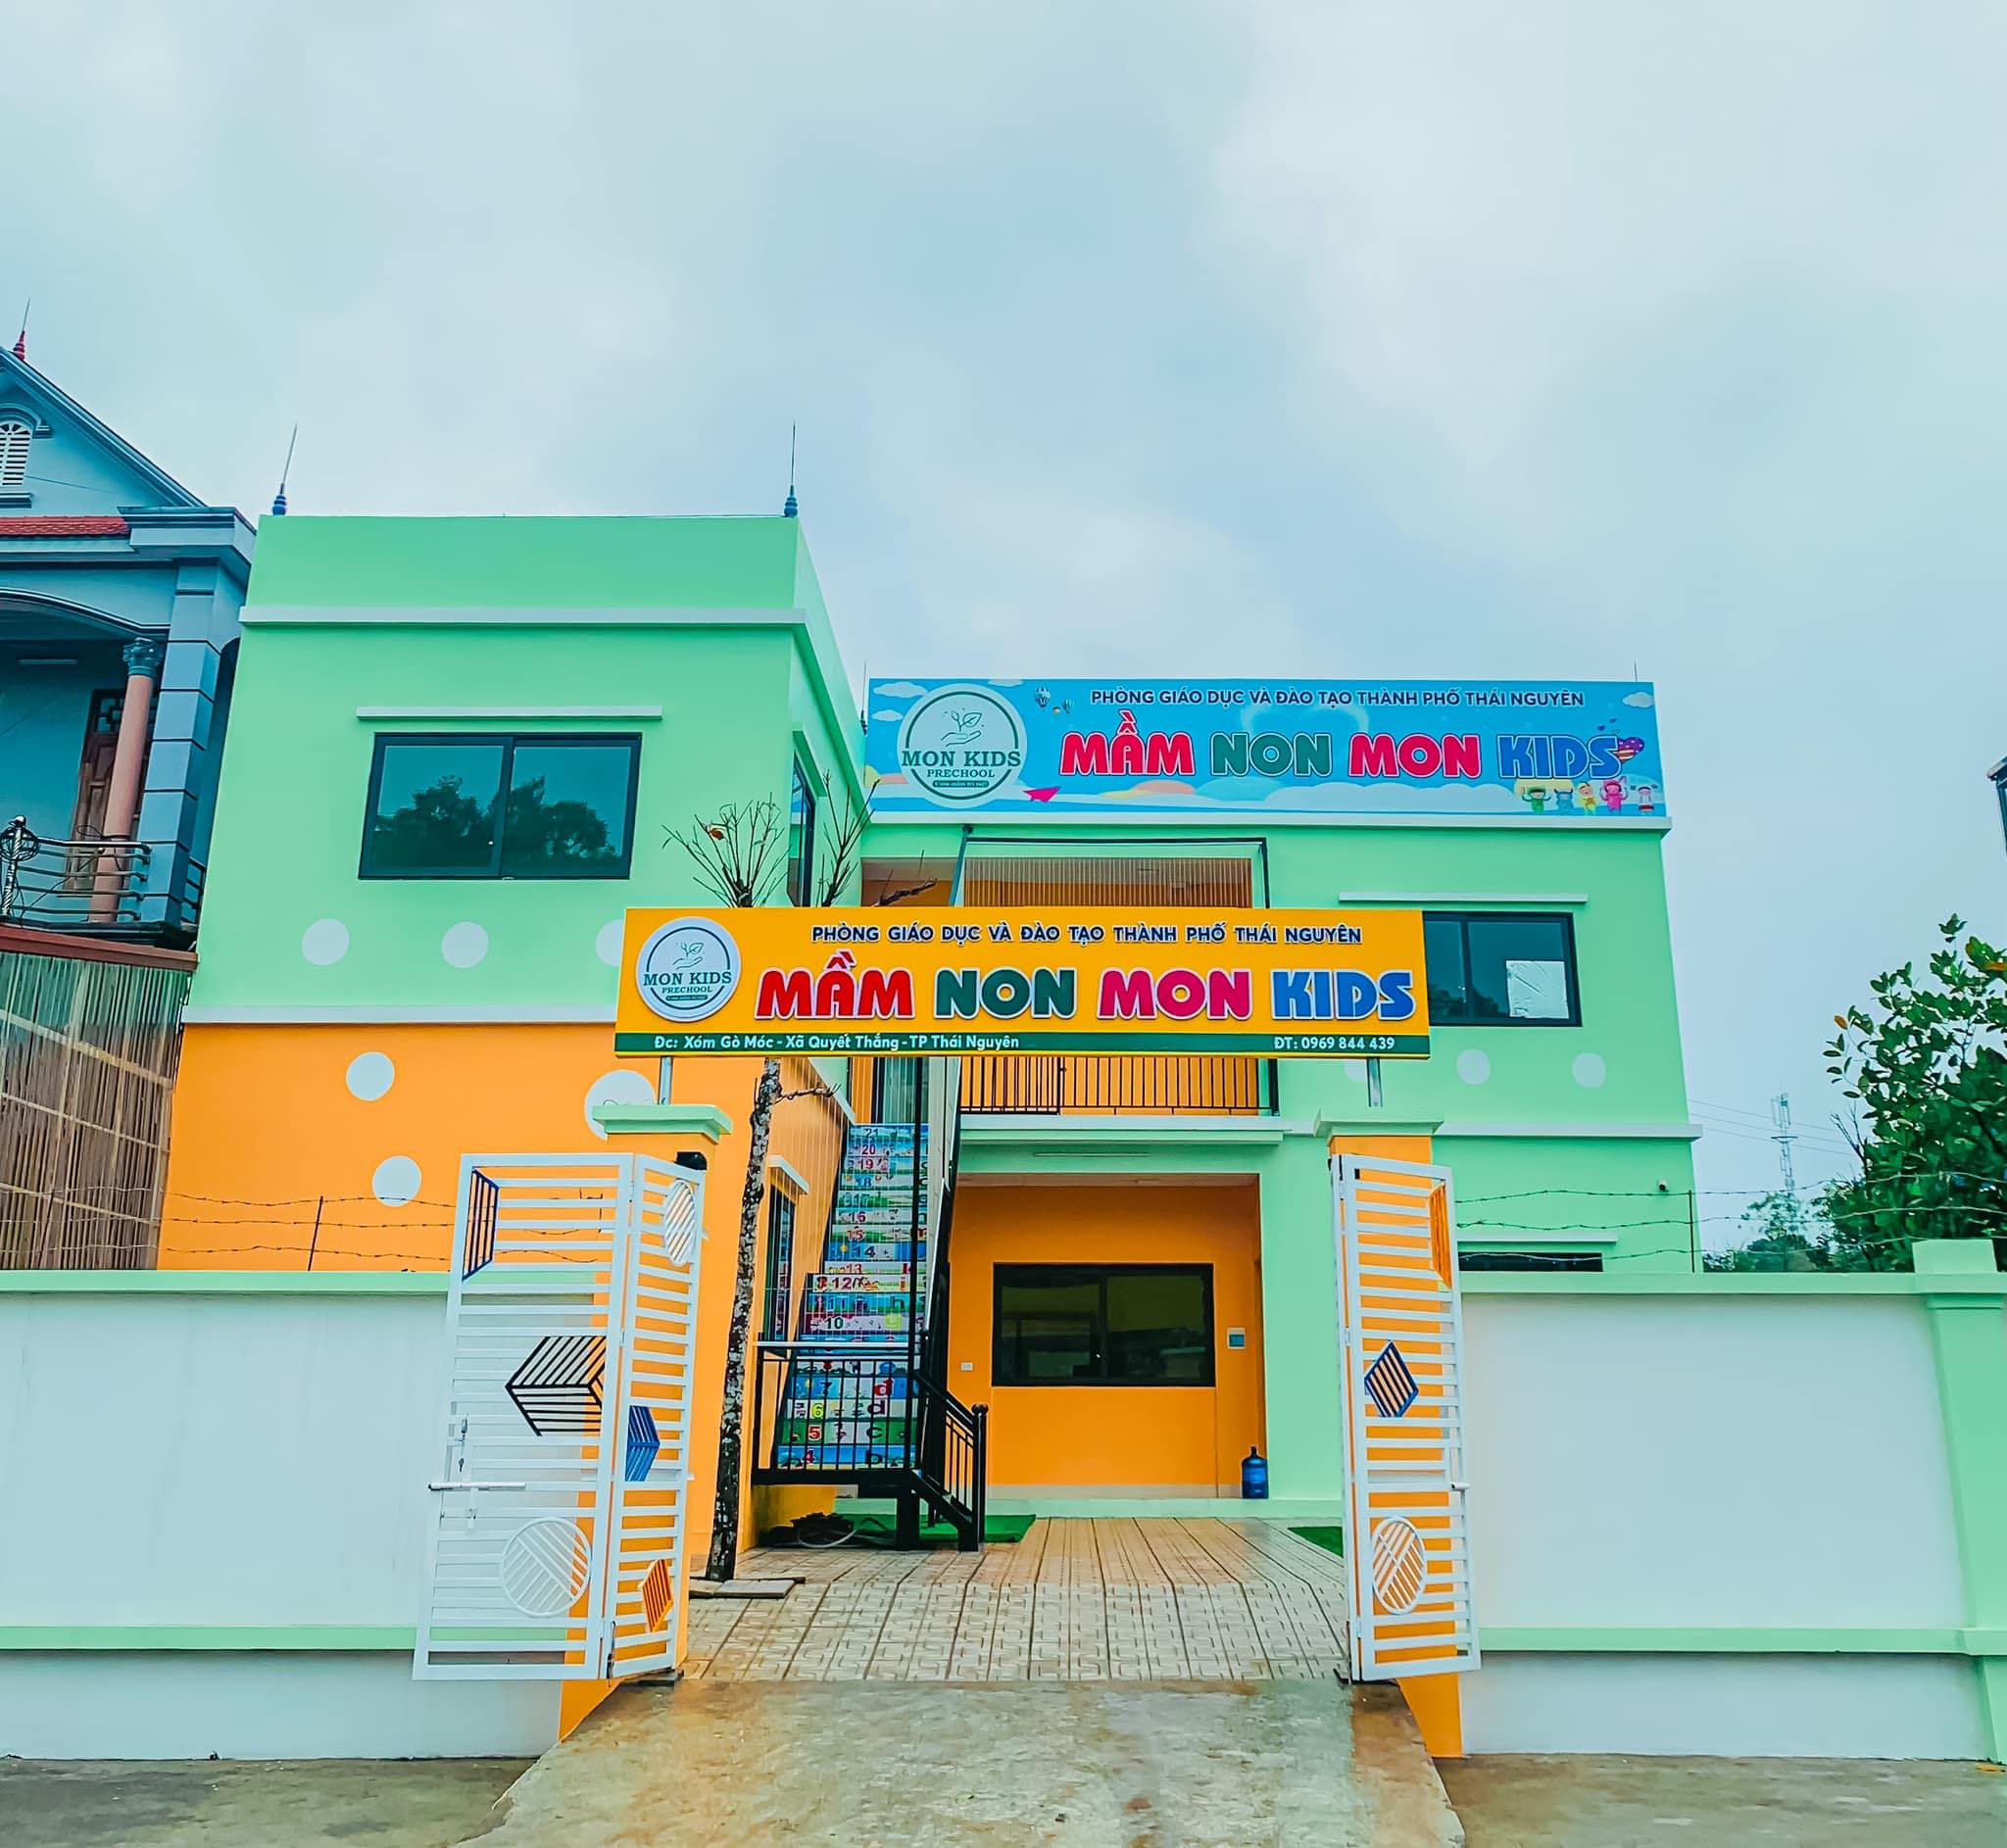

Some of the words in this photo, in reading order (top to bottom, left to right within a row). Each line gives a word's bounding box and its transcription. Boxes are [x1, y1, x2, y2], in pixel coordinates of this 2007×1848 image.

[1091, 687, 1153, 704] PHÒNG
[1159, 687, 1202, 704] GIÁO
[1207, 690, 1244, 707] DỤC
[1249, 688, 1271, 705] VÀ
[1276, 688, 1313, 705] ĐÀO
[1318, 690, 1352, 708] TẠO
[1357, 688, 1418, 705] THÀNH
[1423, 688, 1461, 705] PHỐ
[1465, 688, 1506, 705] THÁI
[1510, 689, 1585, 706] NGUYÊN
[1059, 708, 1196, 776] MẦM
[1209, 733, 1333, 777] NON
[1348, 733, 1483, 778] MON
[1496, 734, 1622, 779] KIDS
[902, 751, 955, 766] MON
[963, 751, 1020, 766] KIDS
[812, 922, 879, 942] PHÒNG
[888, 922, 933, 942] GIÁO
[942, 925, 981, 947] DỤC
[989, 922, 1011, 942] VÀ
[1020, 922, 1060, 942] ĐÀO
[1069, 925, 1104, 947] TẠO
[1113, 922, 1177, 942] THÀNH
[1186, 922, 1227, 943] PHỐ
[1235, 922, 1277, 943] THÁI
[1285, 924, 1361, 944] NGUYÊN
[643, 973, 683, 986] MON
[689, 971, 732, 985] KIDS
[755, 948, 915, 1020] MẦM
[934, 968, 1076, 1020] NON
[1098, 968, 1251, 1020] MON
[1271, 970, 1415, 1021] KIDS
[684, 1035, 715, 1048] Xóm
[720, 1036, 741, 1048] Gò
[744, 1035, 773, 1048] Móc
[785, 1035, 805, 1048] Xã
[808, 1034, 851, 1050] Quyết
[856, 1034, 899, 1050] Thắng
[909, 1036, 928, 1048] TP
[931, 1035, 961, 1048] Thái
[966, 1035, 1019, 1050] Nguyên
[1301, 1037, 1335, 1049] 0969
[1339, 1037, 1365, 1049] 844
[1369, 1037, 1395, 1049] 439
[862, 1143, 876, 1155] 20
[857, 1158, 873, 1170] 19
[856, 1177, 872, 1188] 18
[849, 1210, 866, 1223] 16
[853, 1245, 876, 1258] 14
[832, 1277, 853, 1289] 12
[824, 1317, 844, 1329] 10
[811, 1402, 824, 1419] 6
[808, 1426, 822, 1441] 5
